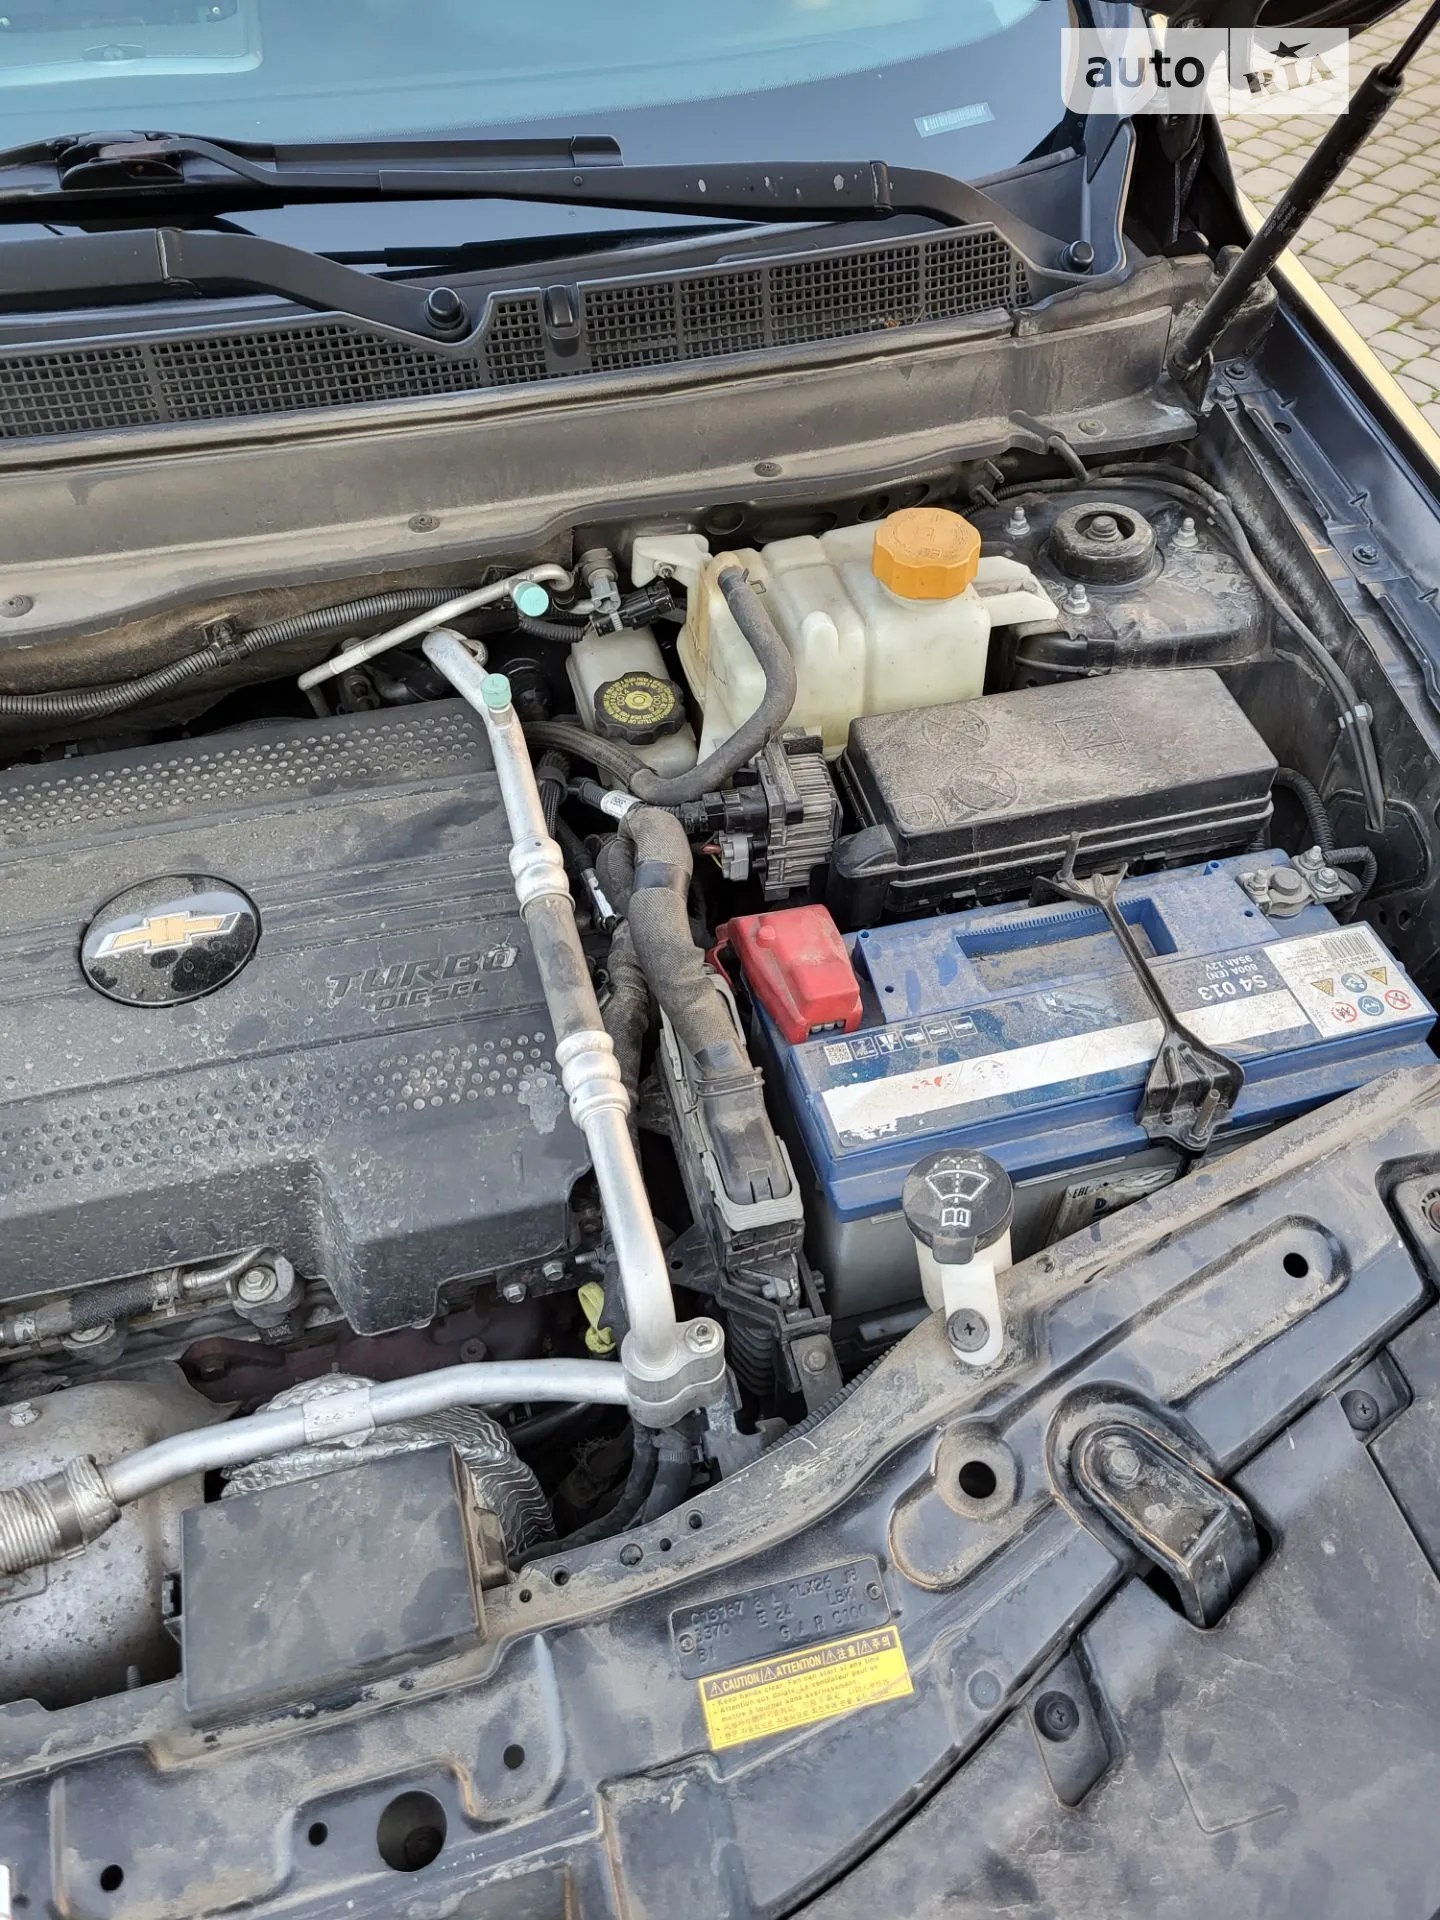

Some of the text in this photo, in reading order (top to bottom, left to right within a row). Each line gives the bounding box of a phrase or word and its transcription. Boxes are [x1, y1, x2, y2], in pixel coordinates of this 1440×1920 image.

[326, 946, 520, 1000] TURBO
[1205, 954, 1254, 971] 95Ah 12V
[1206, 963, 1259, 980] 800A (EN)
[375, 979, 489, 1011] DIESEL
[1197, 974, 1268, 1001] S4 013
[871, 1634, 891, 1651] 주의
